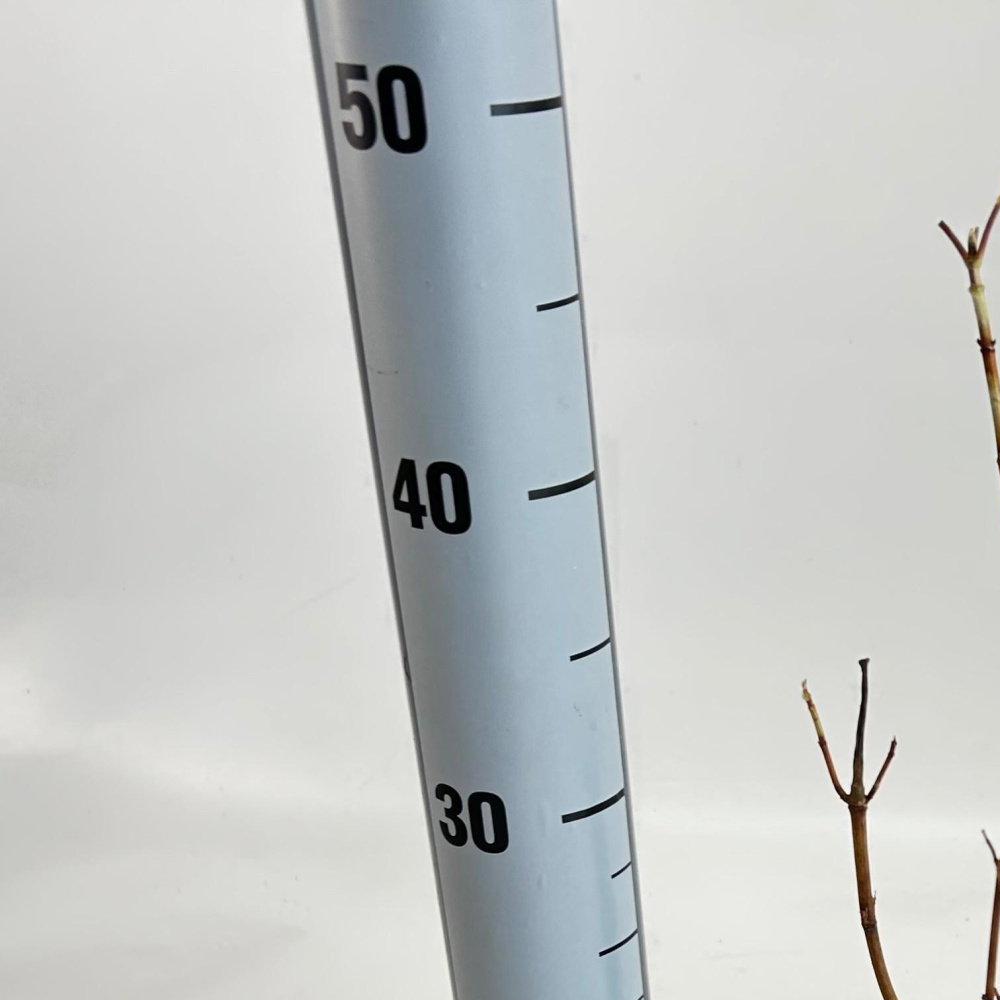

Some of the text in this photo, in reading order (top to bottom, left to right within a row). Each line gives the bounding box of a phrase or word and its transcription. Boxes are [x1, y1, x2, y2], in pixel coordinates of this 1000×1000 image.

[337, 63, 428, 154] 50
[392, 458, 472, 535] 40
[434, 783, 510, 854] 30
